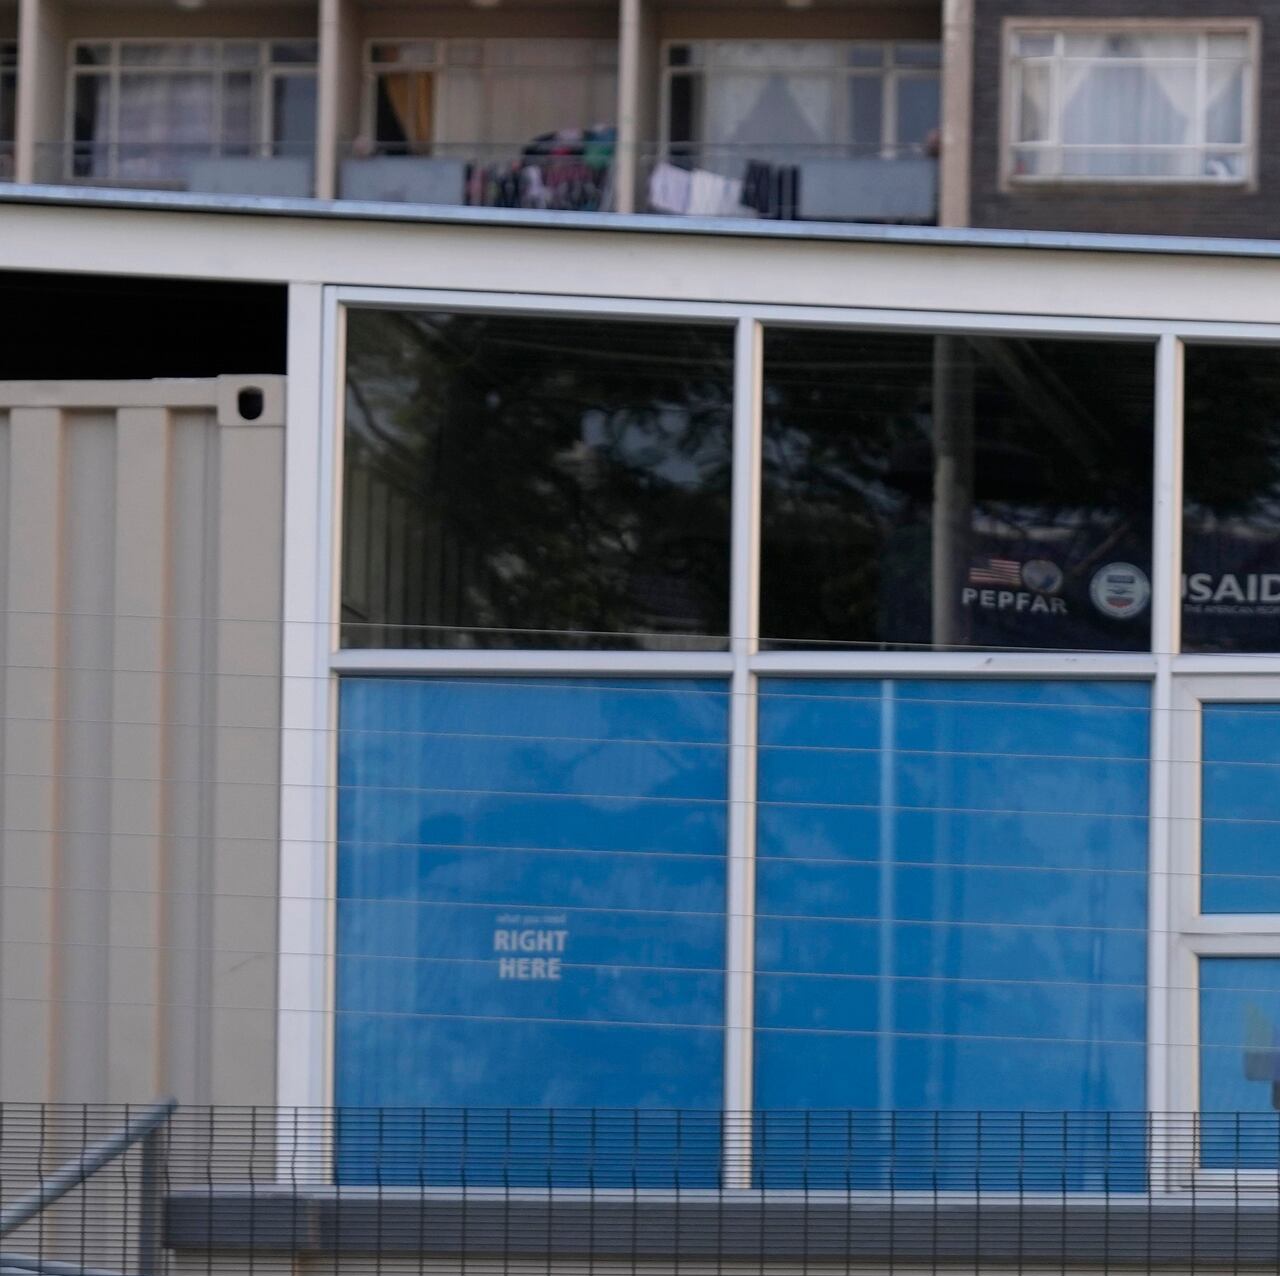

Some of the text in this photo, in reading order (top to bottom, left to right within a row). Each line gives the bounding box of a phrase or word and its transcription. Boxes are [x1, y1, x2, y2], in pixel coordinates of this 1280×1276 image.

[962, 587, 1068, 614] PEPFAR
[493, 929, 569, 952] RIGHT
[498, 957, 561, 980] HERE
